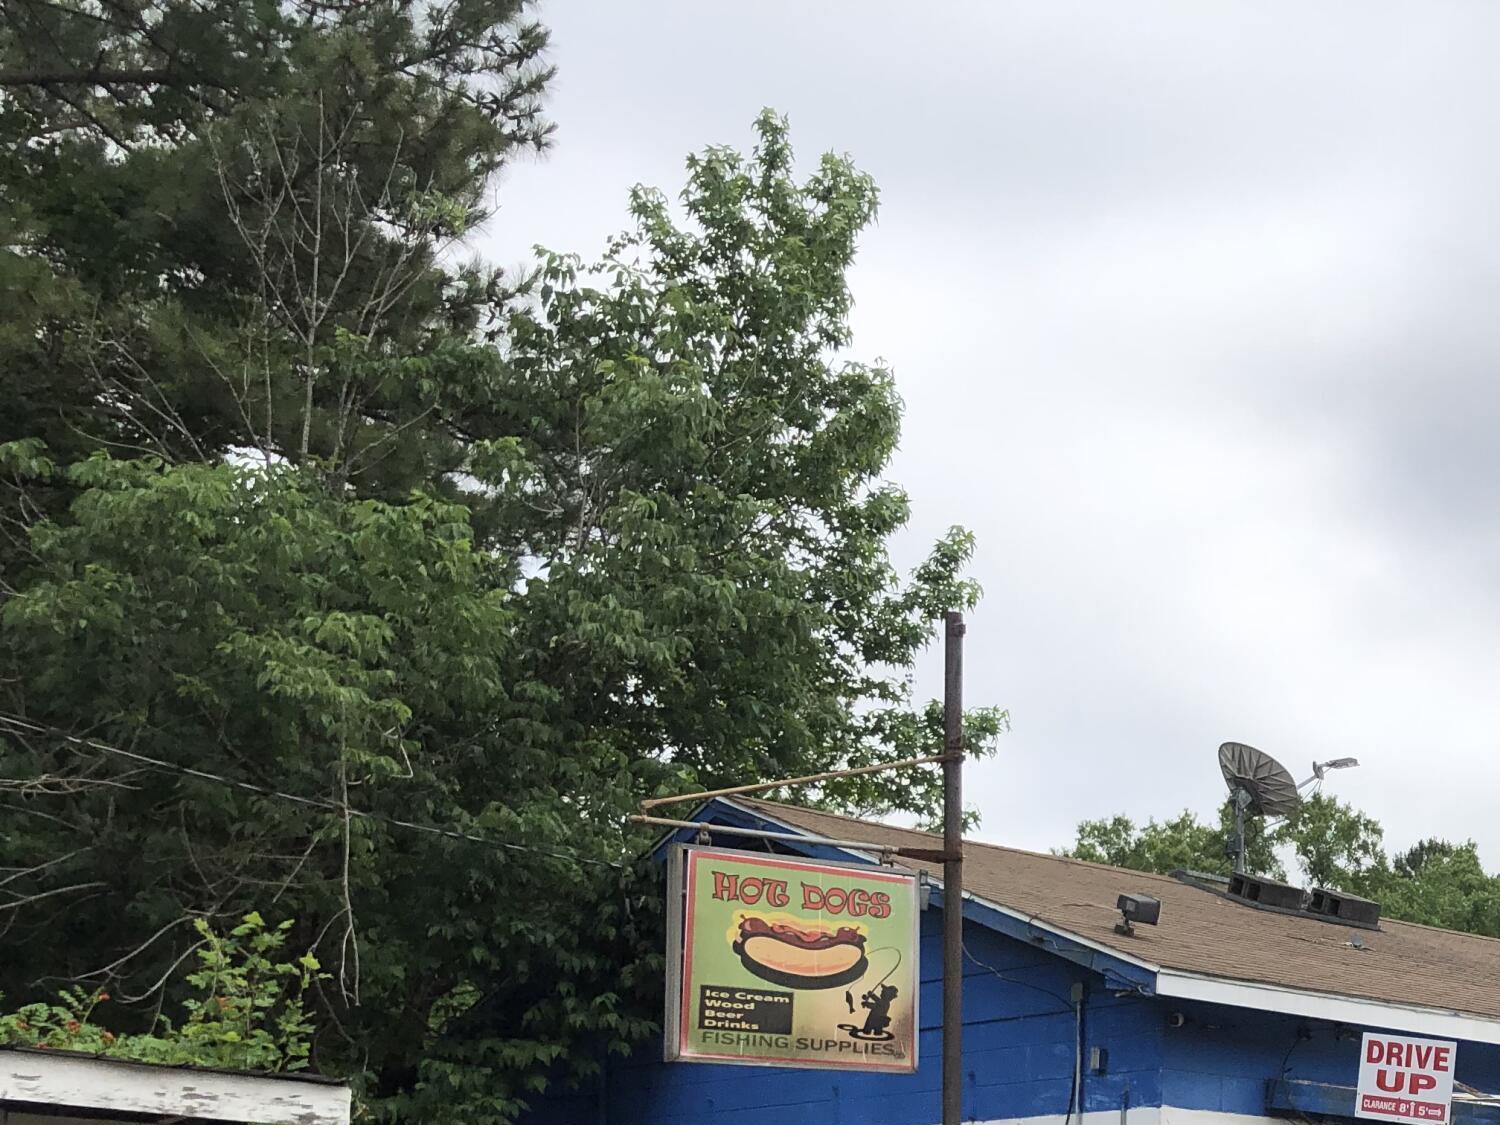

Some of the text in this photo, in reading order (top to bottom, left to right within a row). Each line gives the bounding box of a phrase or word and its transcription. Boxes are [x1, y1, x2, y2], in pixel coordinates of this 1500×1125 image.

[712, 871, 891, 918] HOT DOGS
[705, 989, 790, 1003] Ice Cream
[705, 999, 755, 1010] Wood
[705, 1009, 744, 1020] Beer
[704, 1019, 760, 1031] Drinks
[701, 1031, 895, 1055] FISHING SUPPLIES
[1366, 1039, 1450, 1072] DRIVE
[1376, 1069, 1437, 1095] UP
